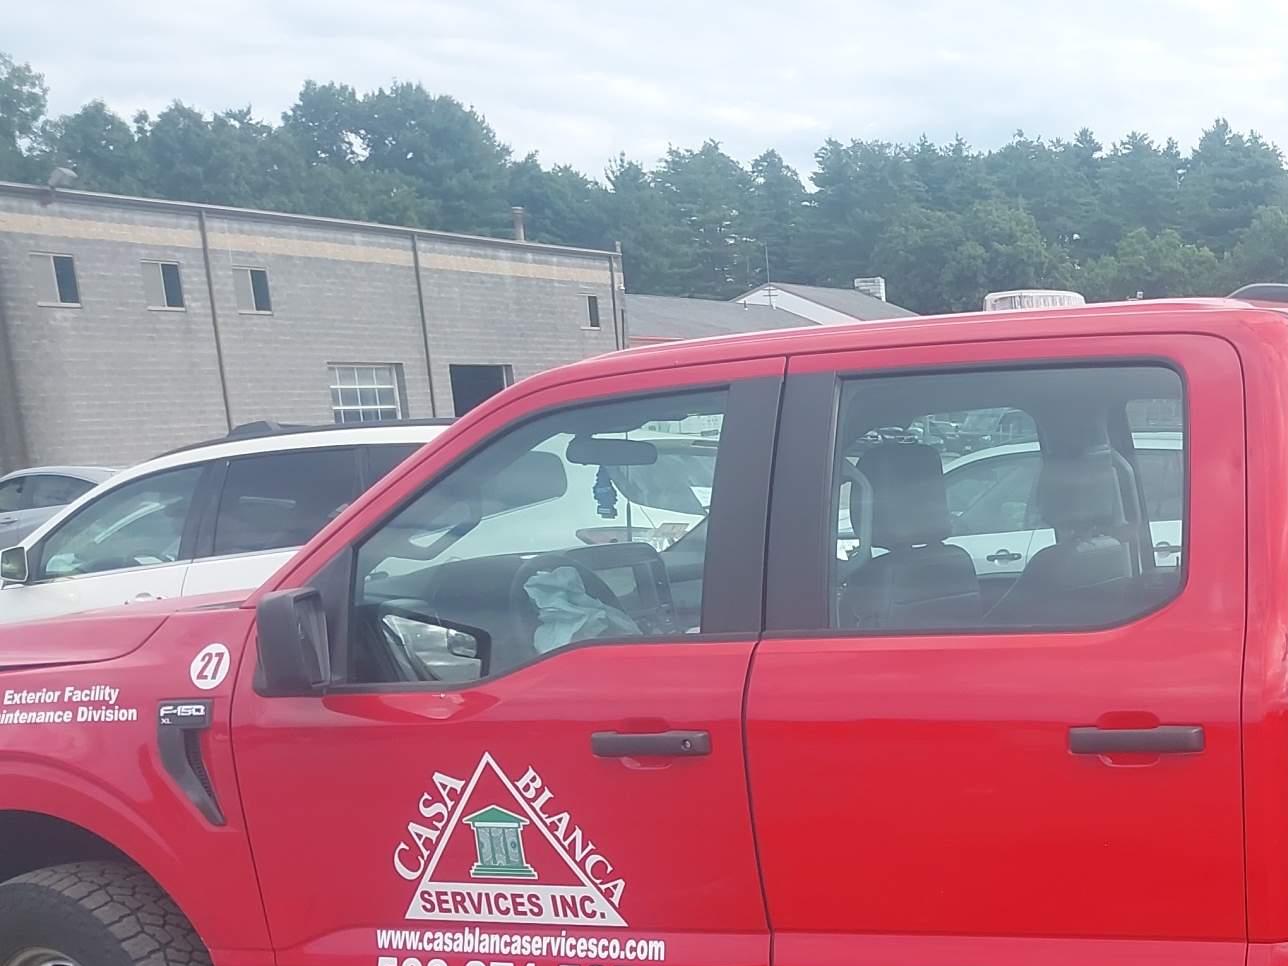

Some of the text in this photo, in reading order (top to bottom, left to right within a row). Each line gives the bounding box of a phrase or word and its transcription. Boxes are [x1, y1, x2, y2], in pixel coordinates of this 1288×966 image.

[196, 652, 225, 680] 27
[3, 685, 119, 705] Exterior Facility
[0, 706, 137, 724] intenance Division
[160, 704, 206, 717] F-150
[393, 766, 626, 909] CASA BLANCA
[419, 889, 607, 920] SERVICES INC.
[376, 927, 665, 961] www.casablancaservicesco.com
